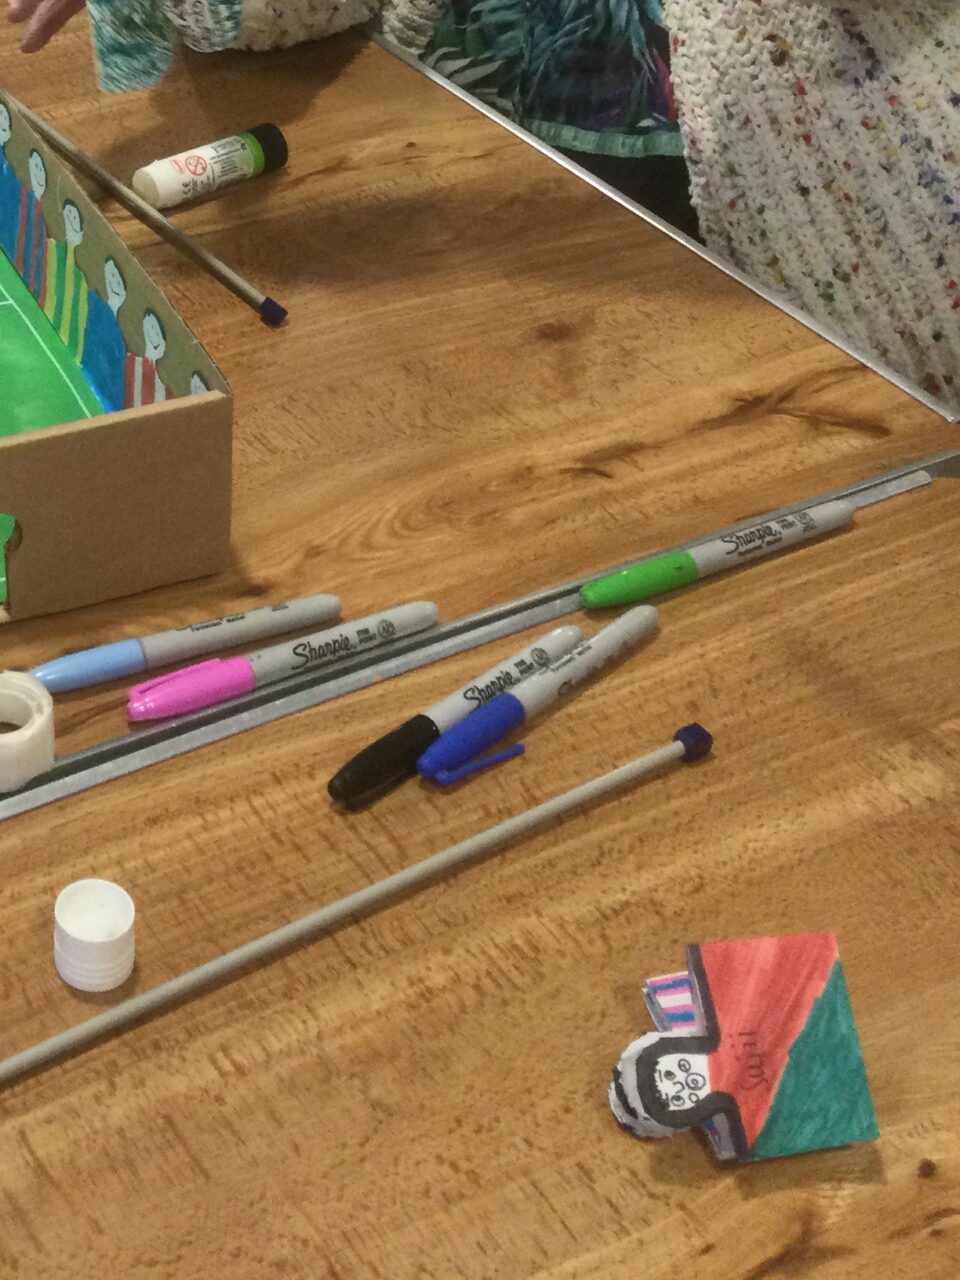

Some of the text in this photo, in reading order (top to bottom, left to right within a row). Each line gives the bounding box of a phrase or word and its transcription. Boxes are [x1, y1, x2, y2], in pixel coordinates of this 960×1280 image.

[721, 524, 778, 555] Sharpie
[291, 634, 352, 670] Sharpie
[463, 670, 514, 712] Sharpie
